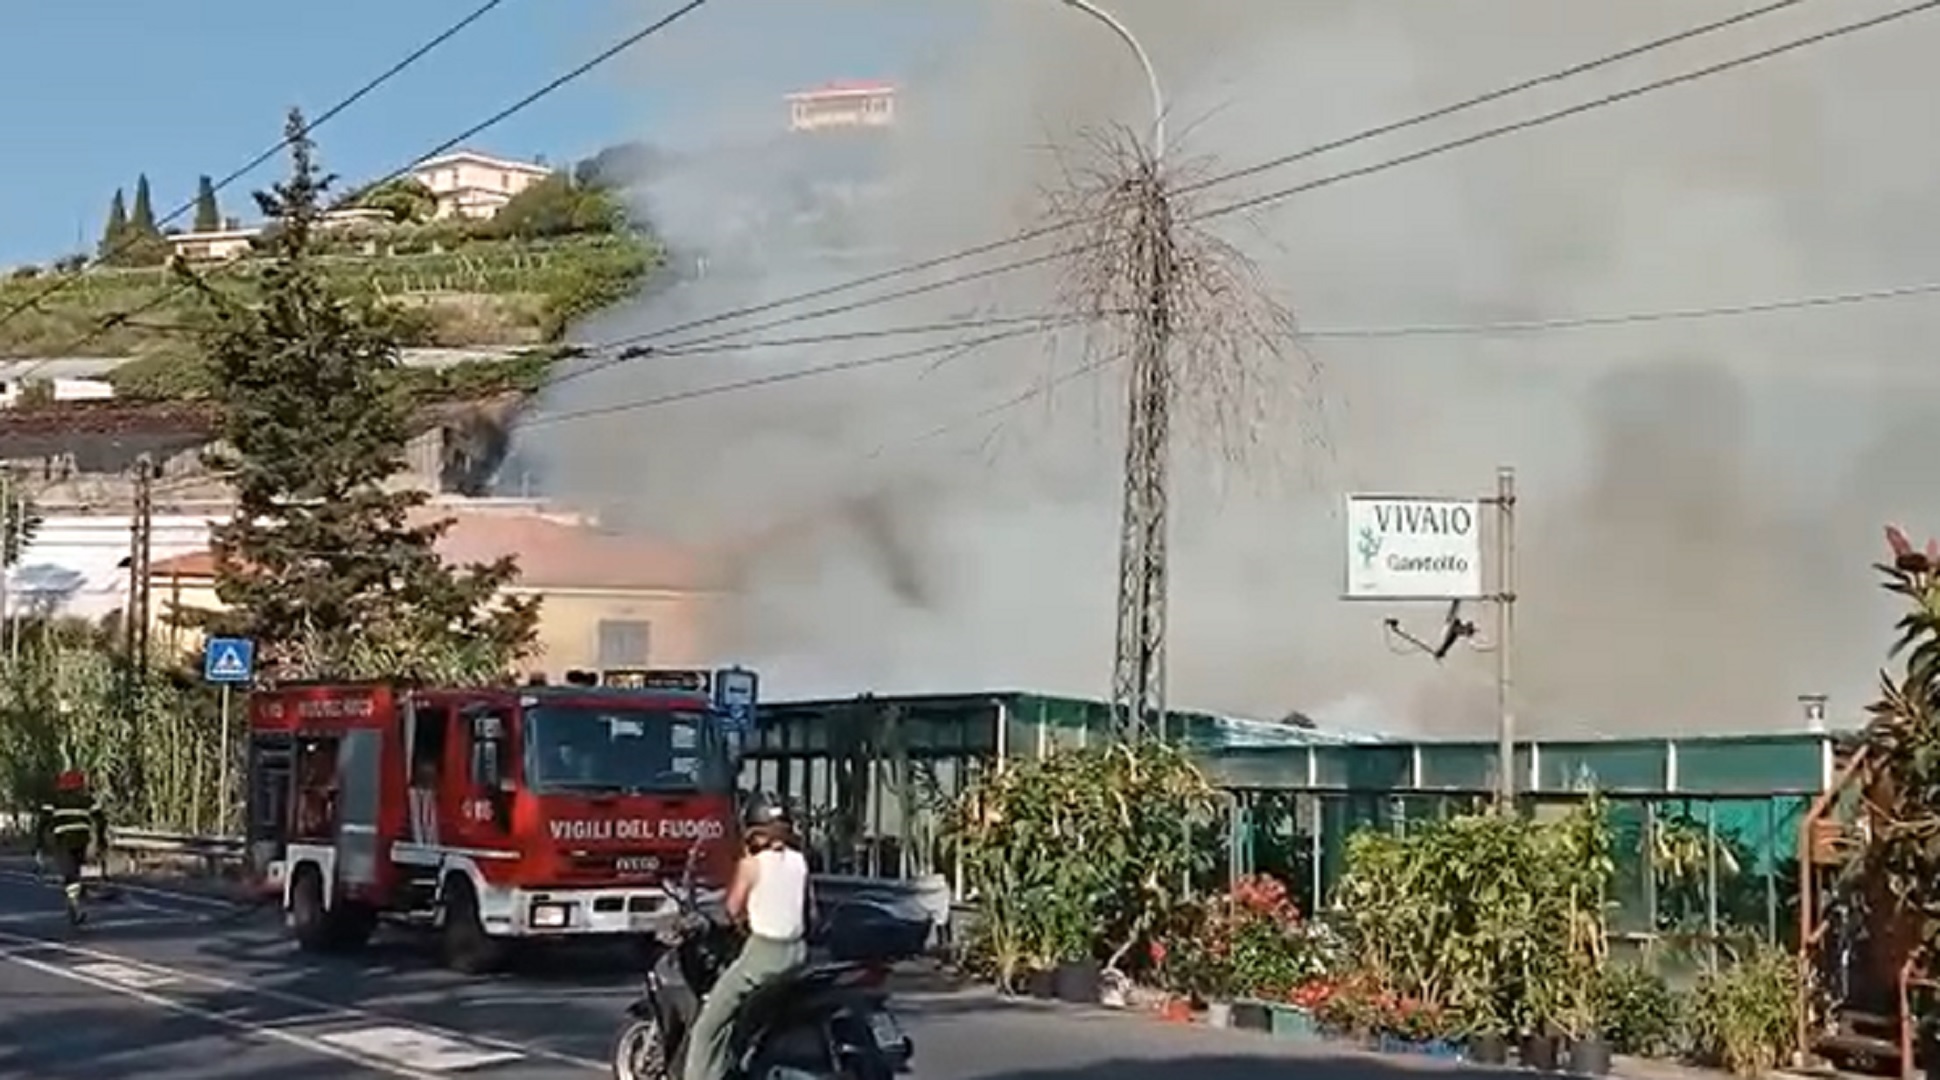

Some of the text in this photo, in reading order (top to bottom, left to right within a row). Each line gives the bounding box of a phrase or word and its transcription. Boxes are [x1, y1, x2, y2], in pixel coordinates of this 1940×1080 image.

[1374, 504, 1472, 535] VIVAIO
[549, 819, 613, 839] VIGILI
[615, 819, 654, 839] DEL
